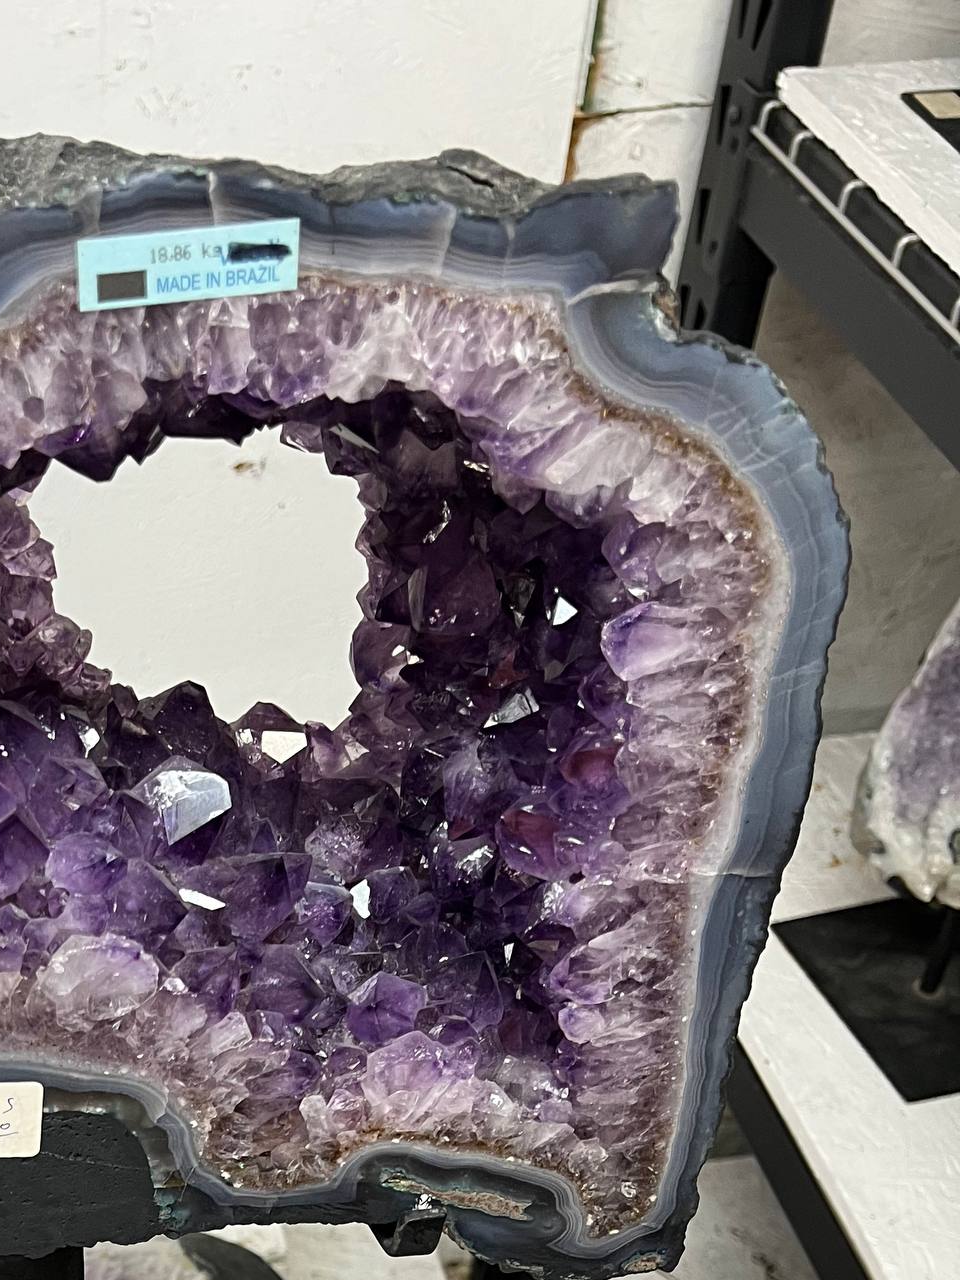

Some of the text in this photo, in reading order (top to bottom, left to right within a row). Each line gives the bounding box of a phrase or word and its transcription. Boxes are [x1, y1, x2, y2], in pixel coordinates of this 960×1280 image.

[150, 244, 192, 264] 18.86
[156, 265, 280, 294] MADE IN BRAZIL
